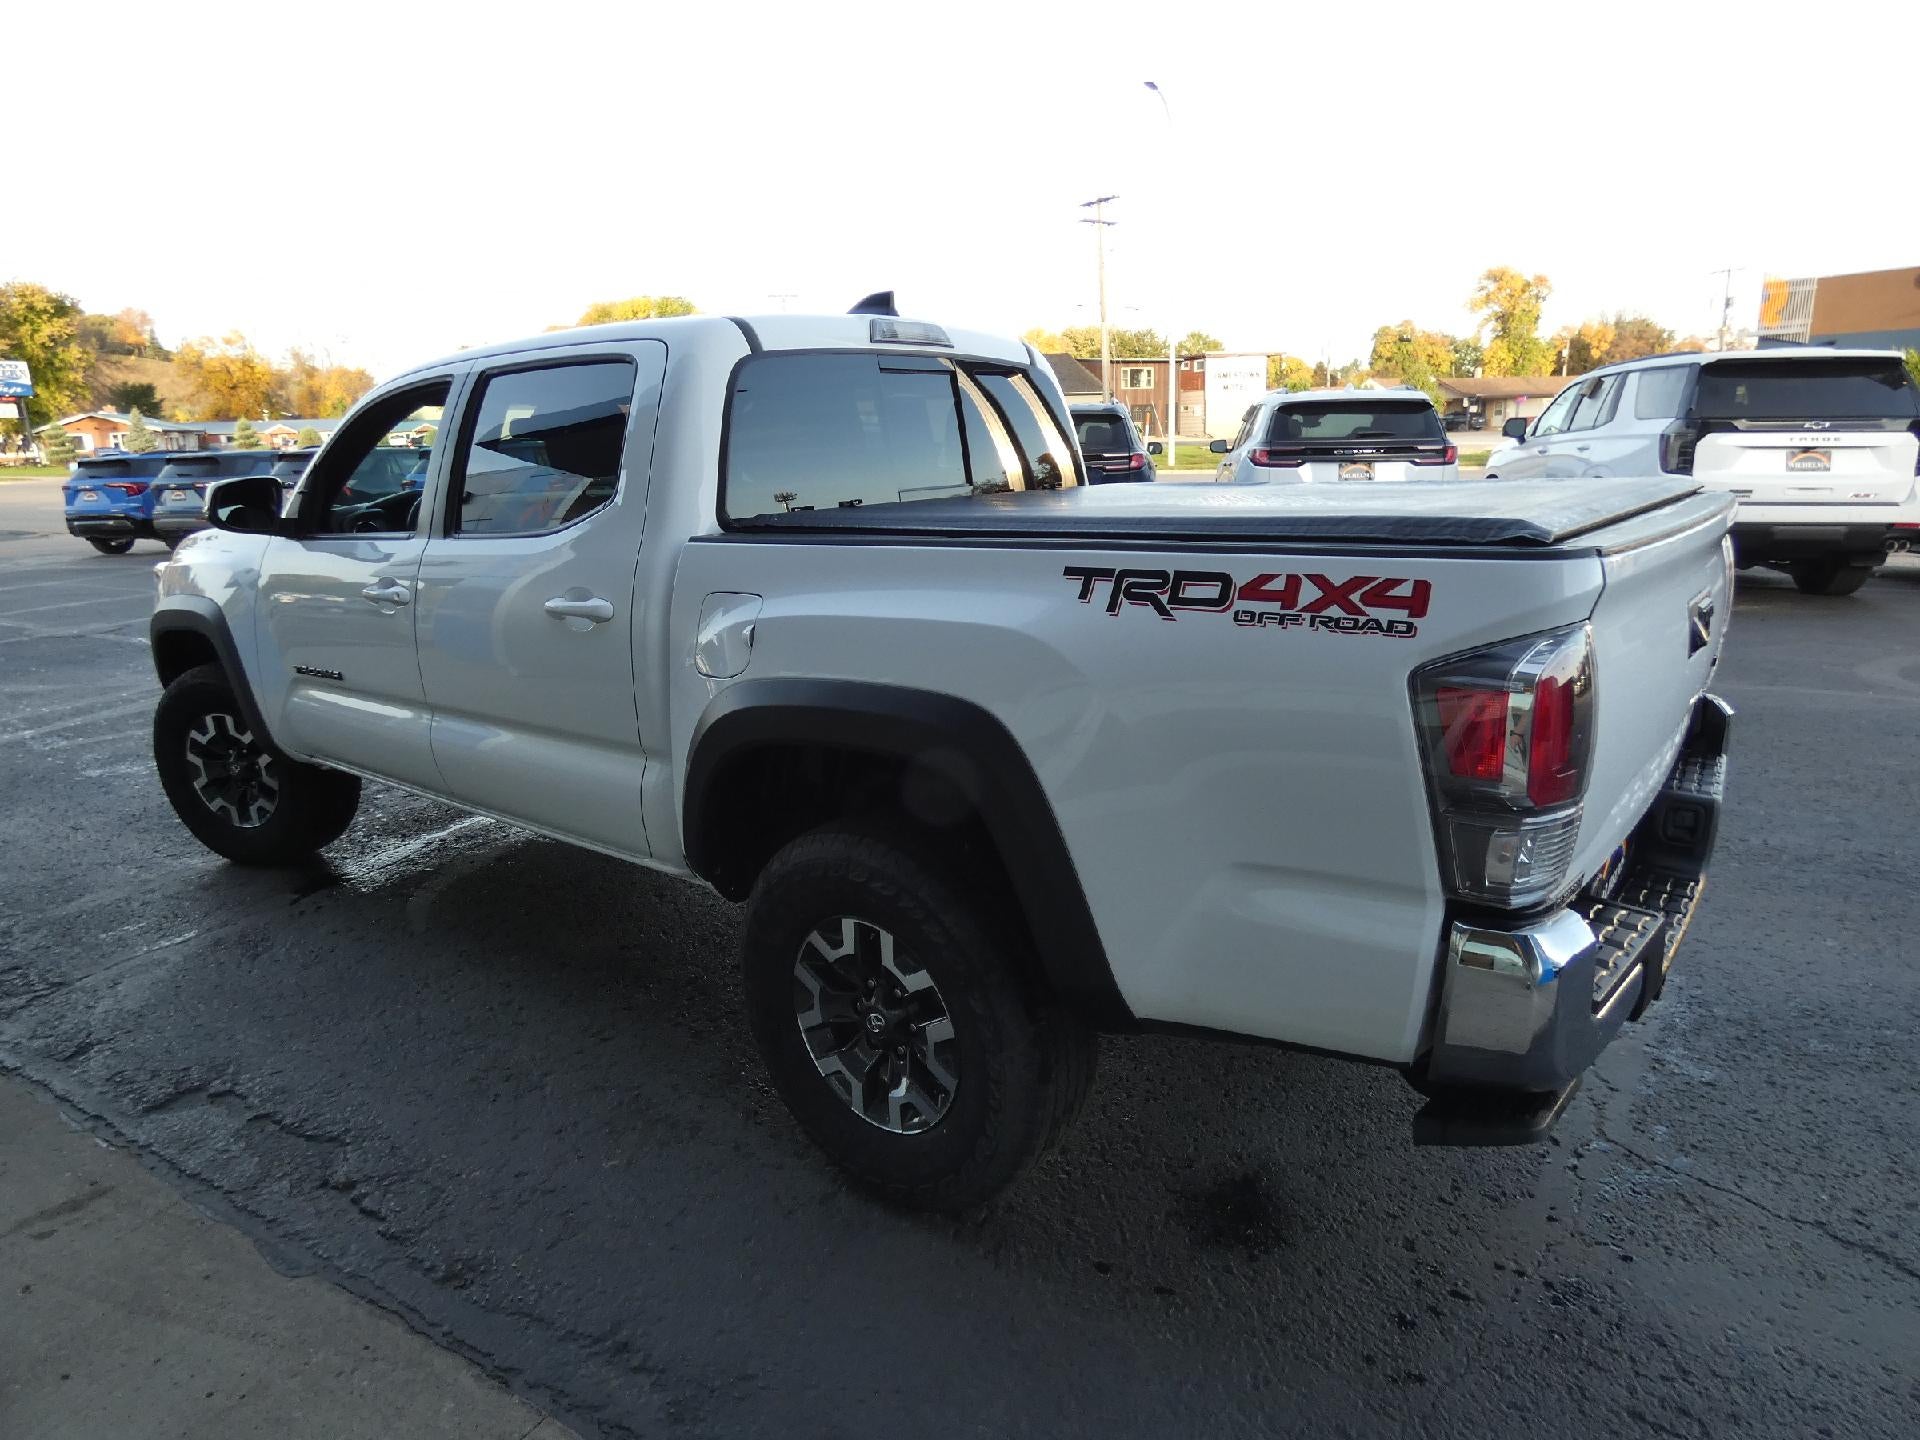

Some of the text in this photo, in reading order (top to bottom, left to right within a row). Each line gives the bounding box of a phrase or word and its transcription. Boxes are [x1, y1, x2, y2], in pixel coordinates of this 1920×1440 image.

[1063, 566, 1236, 621] TRD
[1233, 610, 1419, 638] OFF ROAD
